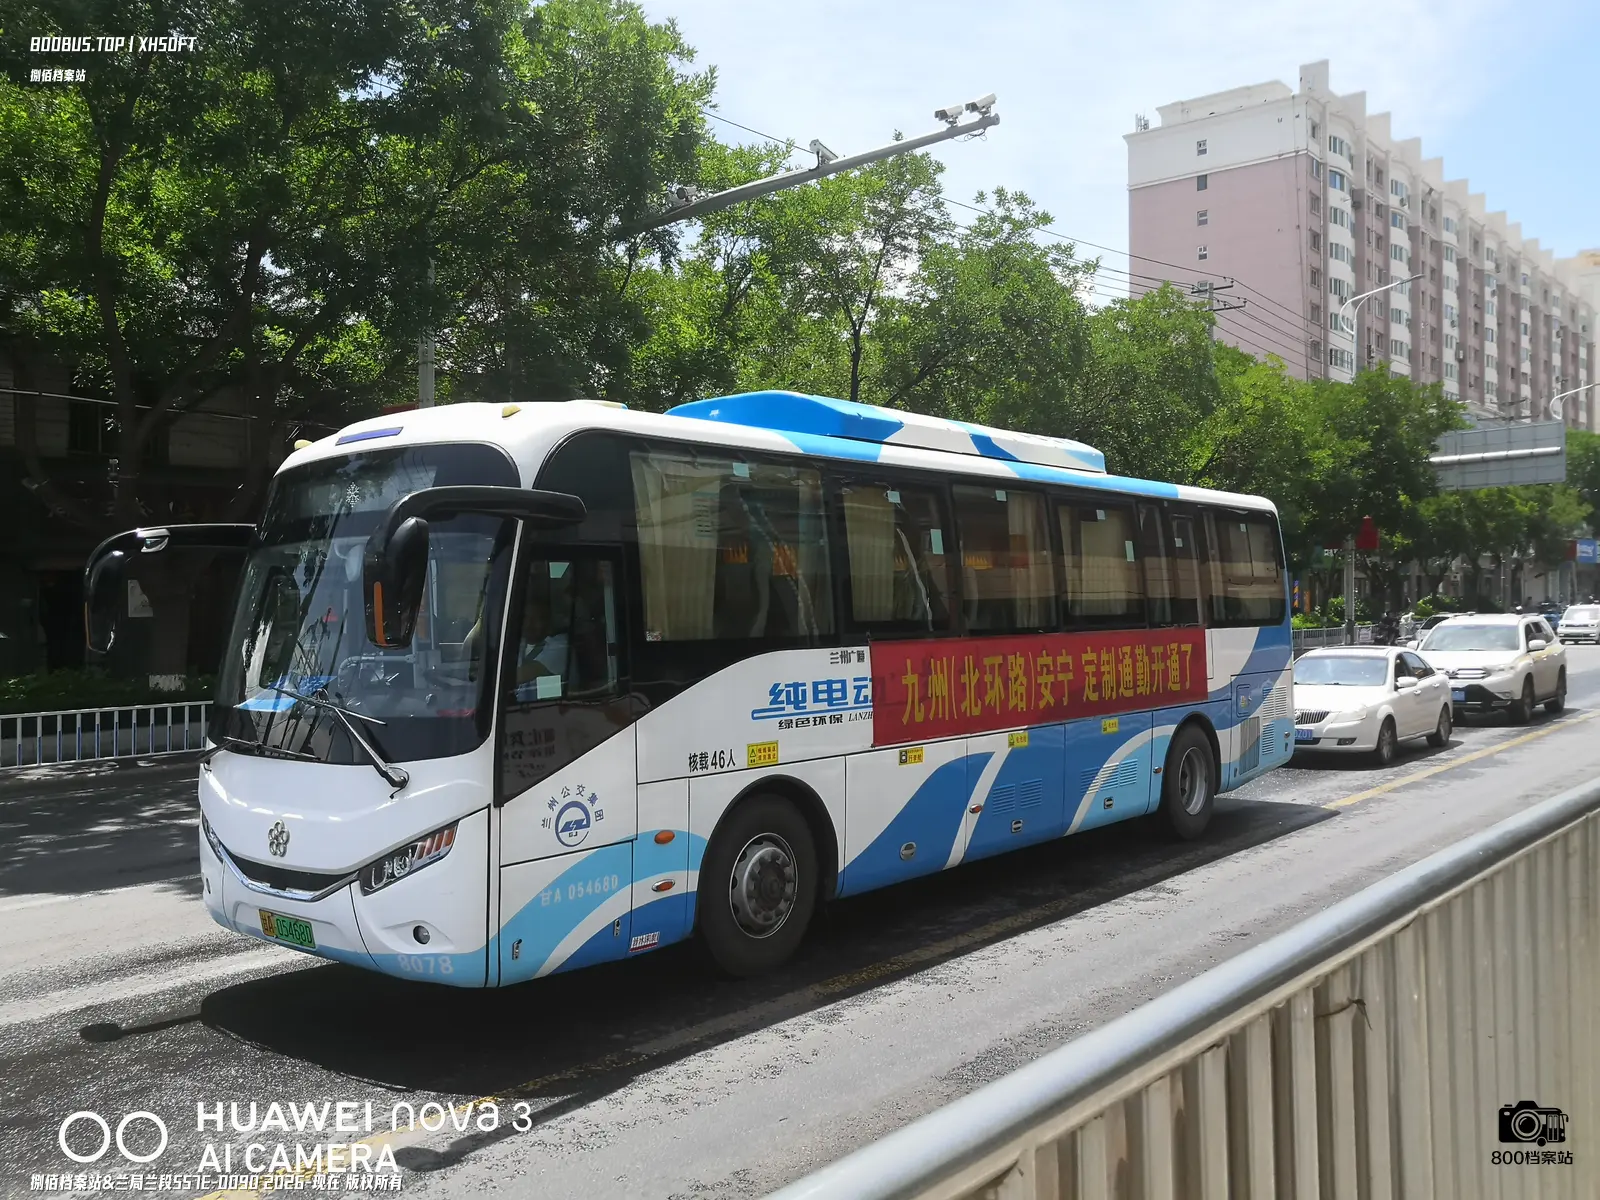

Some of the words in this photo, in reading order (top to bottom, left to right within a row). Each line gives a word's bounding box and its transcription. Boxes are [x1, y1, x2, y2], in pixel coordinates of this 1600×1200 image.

[1082, 643, 1193, 702] 定制通勤开通了
[778, 714, 843, 730] 绿色环保
